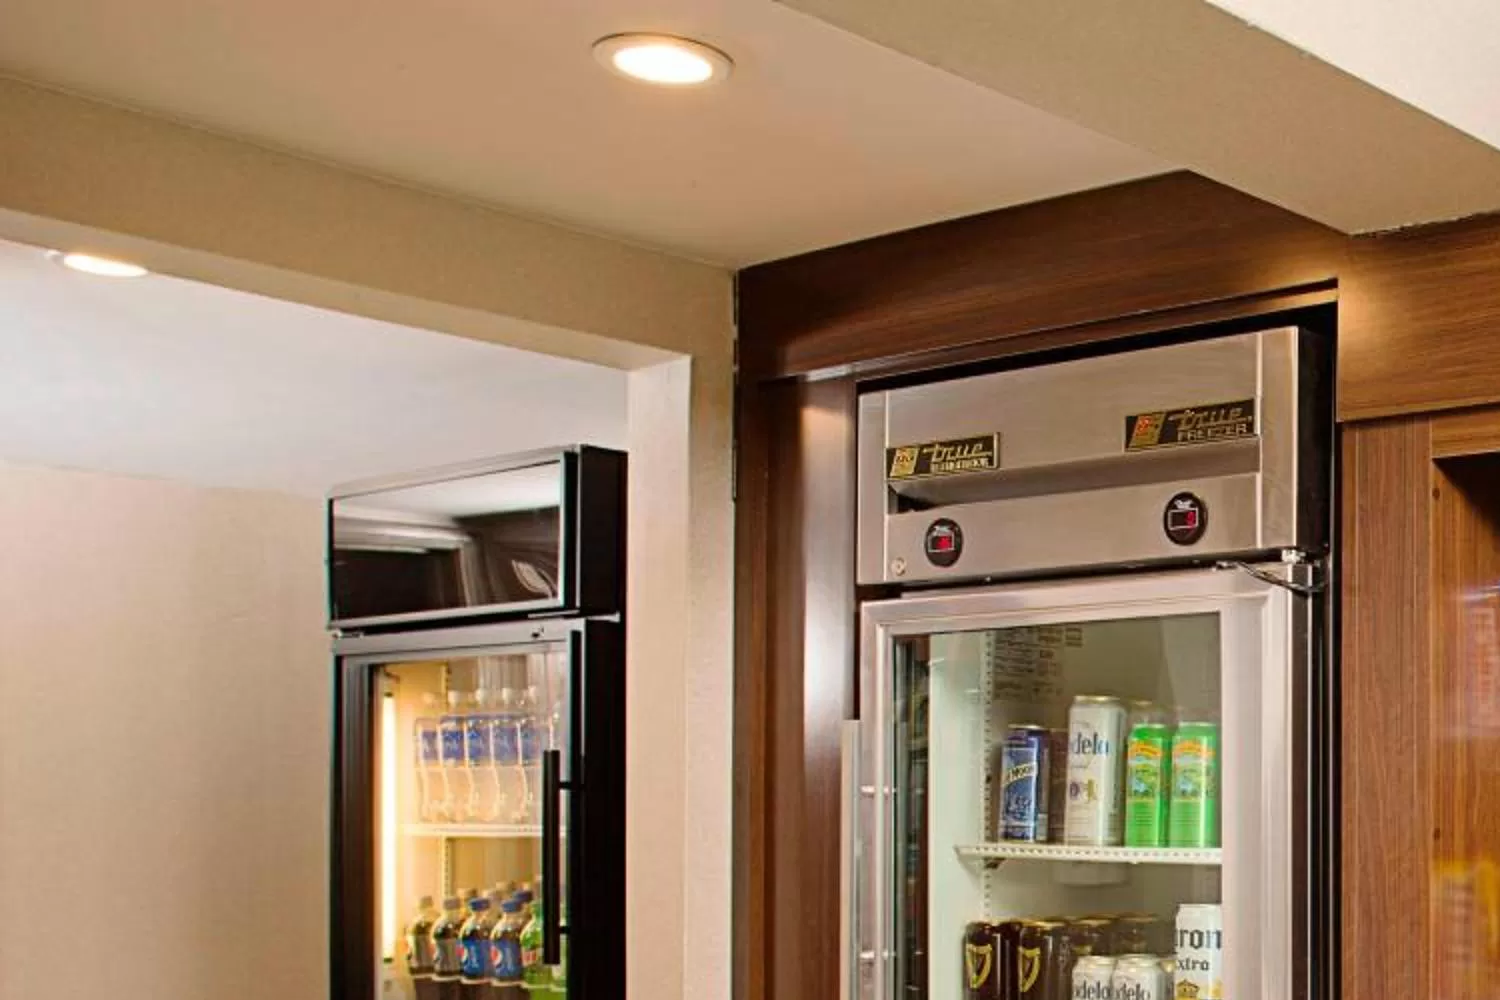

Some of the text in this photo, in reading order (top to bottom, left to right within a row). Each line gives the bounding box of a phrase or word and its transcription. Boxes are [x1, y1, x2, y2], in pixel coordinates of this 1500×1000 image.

[1072, 731, 1110, 756] delo
[1177, 958, 1210, 971] xtra
[1075, 979, 1111, 1000] delo
